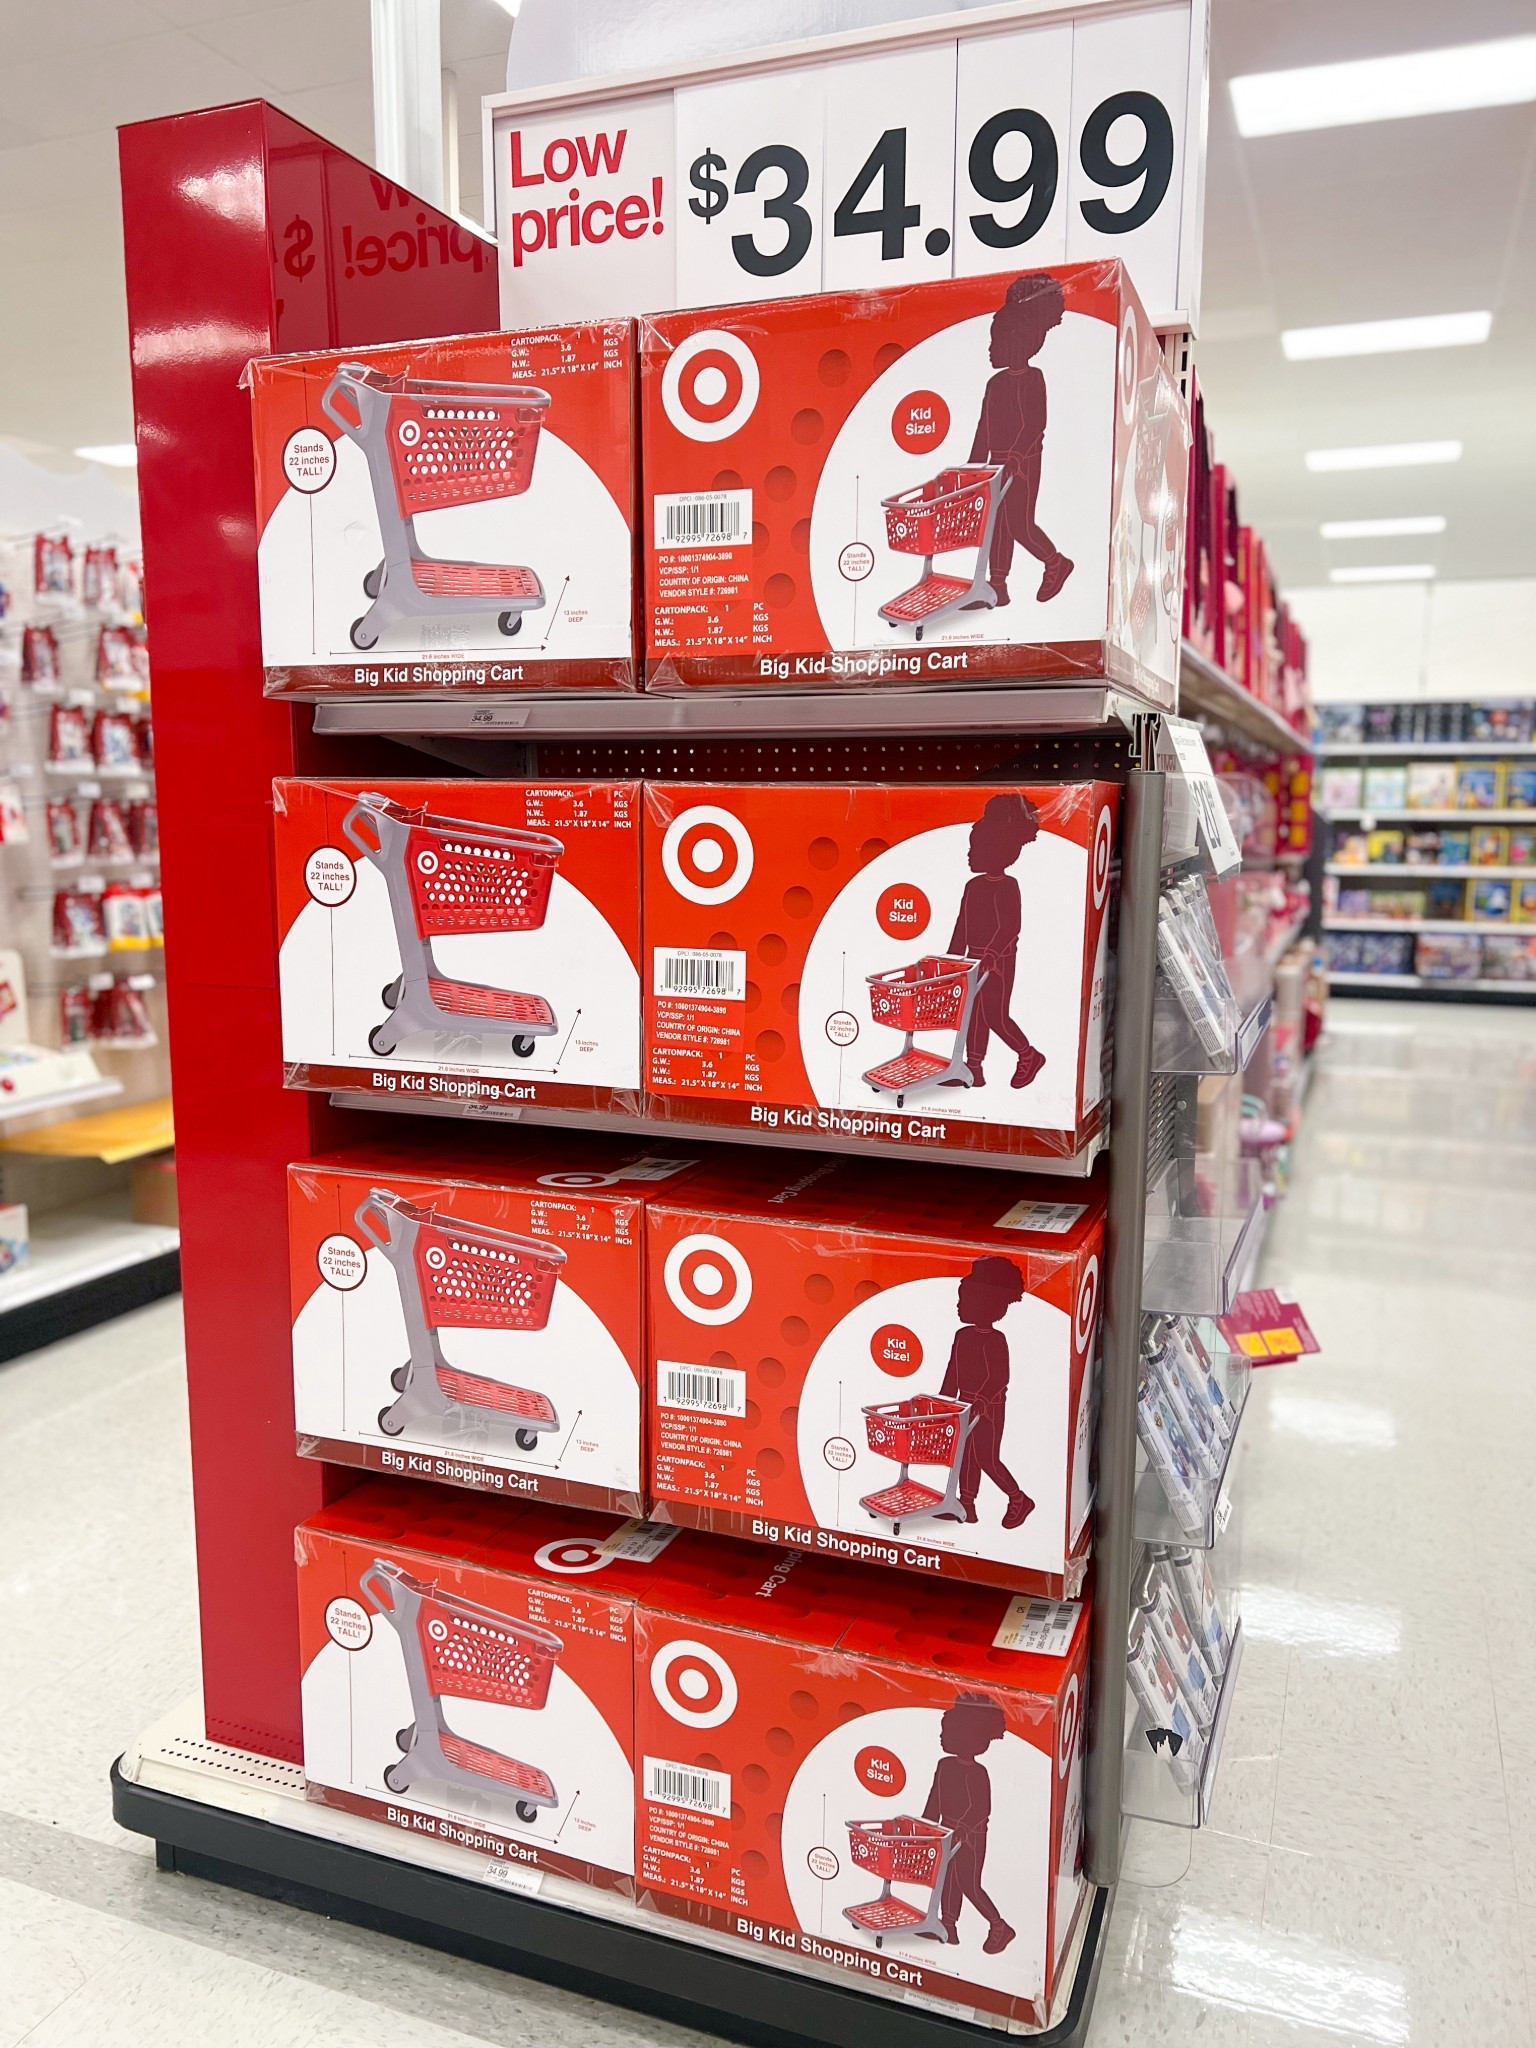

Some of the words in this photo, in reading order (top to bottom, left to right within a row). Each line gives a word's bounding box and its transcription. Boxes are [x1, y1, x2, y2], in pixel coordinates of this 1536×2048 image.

[510, 129, 628, 188] Low
[688, 90, 1175, 277] $34.99
[512, 177, 663, 268] price!
[511, 334, 561, 346] CARTONPACK:
[512, 349, 529, 357] G.W.:
[561, 344, 571, 352] 3.6
[604, 338, 618, 346] KGS
[512, 360, 529, 368] N.W.:
[561, 354, 576, 363] 1.87
[604, 349, 618, 357] KGS
[512, 370, 536, 379] MEAS.:
[541, 367, 559, 376] 21.5"
[568, 365, 579, 373] 18"
[587, 362, 598, 371] 14"
[604, 360, 622, 369] INCH
[910, 408, 932, 420] Kid
[905, 422, 936, 436] Size!
[294, 443, 323, 453] Stands
[289, 457, 299, 465] 22
[302, 456, 329, 465] inches
[297, 467, 322, 476] TALL!
[675, 535, 701, 543] 92995
[705, 533, 732, 541] 72698
[660, 577, 690, 586] COUNTRY
[702, 576, 726, 584] ORIGIN:
[728, 574, 749, 582] CHINA
[655, 606, 708, 614] CARTONPACK:
[754, 602, 763, 610] PC
[753, 613, 768, 621] KGS
[686, 637, 705, 646] 21.5"
[714, 636, 726, 644] 18"
[753, 635, 772, 643] INCH
[760, 658, 789, 679] Big
[795, 658, 825, 674] Kid
[831, 654, 921, 676] Shopping
[927, 652, 968, 670] Cart
[354, 669, 379, 686] Big
[384, 668, 408, 683] Kid
[413, 666, 486, 684] Shopping
[490, 665, 523, 680] Cart
[316, 861, 344, 869] Stands
[311, 872, 320, 880] 22
[323, 872, 349, 880] inches
[318, 883, 343, 891] TALL!
[893, 899, 914, 910] Kid
[889, 911, 917, 923] Size!
[674, 986, 698, 994] 92995
[702, 987, 726, 995] 72698
[656, 1021, 685, 1030] COUNTRY
[697, 1025, 720, 1034] ORIGIN:
[721, 1028, 741, 1036] CHINA
[652, 1047, 703, 1058] CARTONPACK:
[746, 1053, 755, 1061] PC
[652, 1057, 670, 1065] G.W.:
[745, 1063, 760, 1072] KGS
[702, 1070, 717, 1078] 1.87
[745, 1073, 759, 1082] KGS
[372, 1072, 396, 1091] Big
[400, 1075, 425, 1091] Kid
[429, 1077, 500, 1099] Shopping
[504, 1083, 536, 1099] Cart
[750, 1106, 779, 1126] Big
[784, 1109, 813, 1127] Kid
[817, 1111, 902, 1139] Shopping
[907, 1120, 947, 1140] Cart
[328, 1247, 355, 1257] Stands
[323, 1257, 333, 1265] 22
[335, 1258, 361, 1268] inches
[330, 1267, 354, 1277] TALL!
[887, 1338, 906, 1349] Kid
[883, 1350, 910, 1362] Size!
[676, 1398, 700, 1407] 92995
[703, 1402, 727, 1411] 72698
[381, 1451, 405, 1470] Big
[408, 1456, 432, 1472] Kid
[435, 1461, 504, 1488] Shopping
[508, 1474, 539, 1492] Cart
[752, 1519, 779, 1541] Big
[784, 1526, 812, 1545] Kid
[816, 1531, 899, 1564] Shopping
[904, 1548, 941, 1570] Cart
[335, 1607, 361, 1621] Stands
[330, 1616, 339, 1625] 22
[341, 1619, 367, 1631] inches
[337, 1626, 360, 1638] TALL!
[871, 1758, 890, 1772] Kid
[866, 1768, 894, 1784] Size!
[386, 1806, 409, 1829] Big
[413, 1813, 435, 1833] Kid
[438, 1821, 505, 1856] Shopping
[508, 1843, 539, 1864] Cart
[487, 1866, 508, 1878] 34.99
[736, 1917, 764, 1941] Big
[768, 1926, 796, 1949] Kid
[800, 1937, 881, 1977] Shopping
[886, 1963, 923, 1987] Cart
